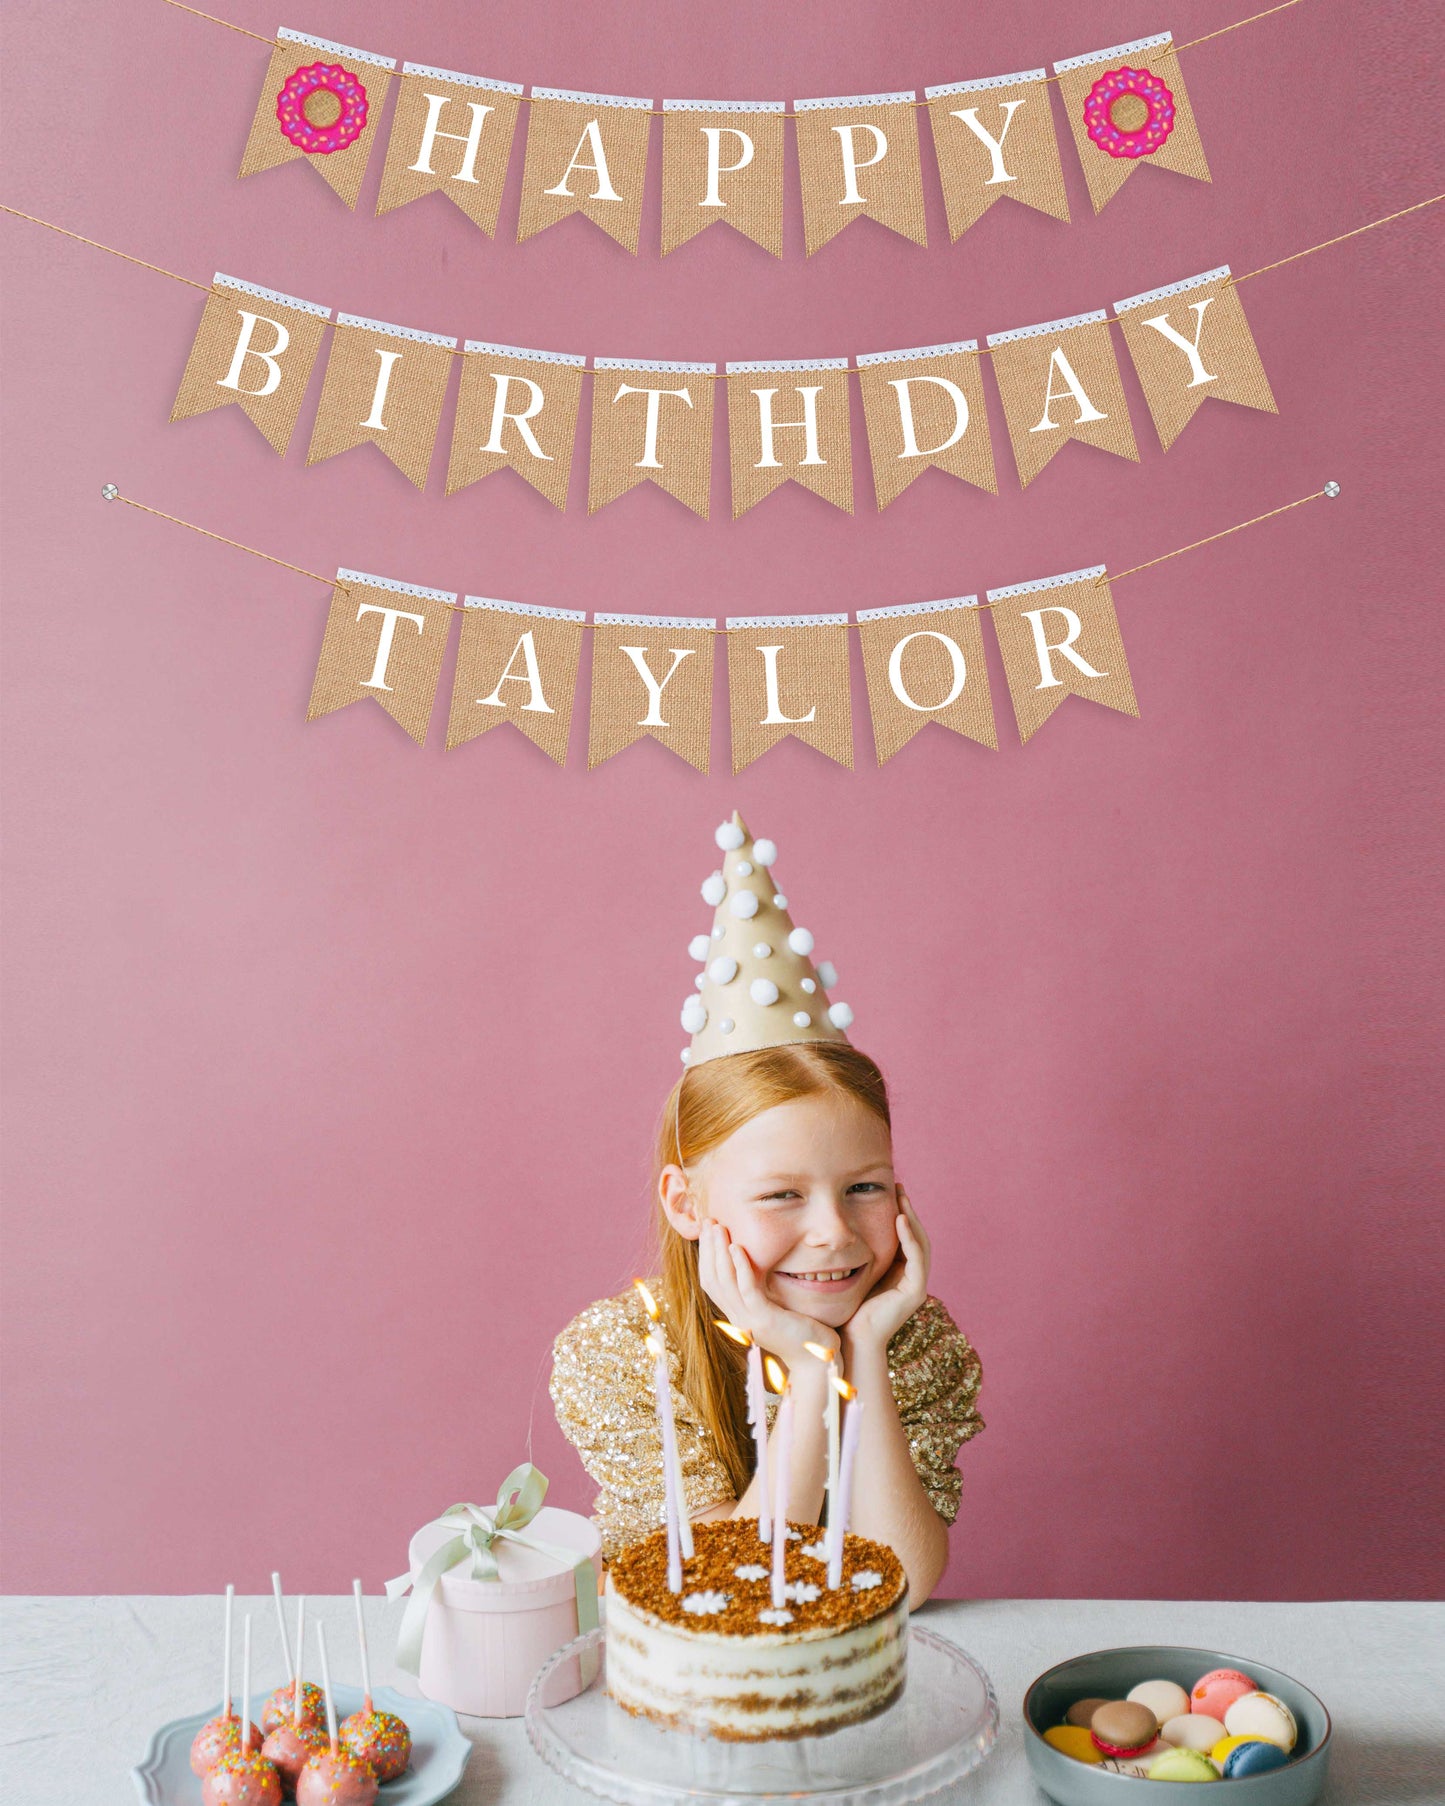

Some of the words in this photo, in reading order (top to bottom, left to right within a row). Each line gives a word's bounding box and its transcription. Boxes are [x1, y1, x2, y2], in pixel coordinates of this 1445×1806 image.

[408, 93, 1026, 207] HAPPY
[215, 297, 1218, 469] BIRTHDAY
[356, 602, 1109, 726] TAYLOR
